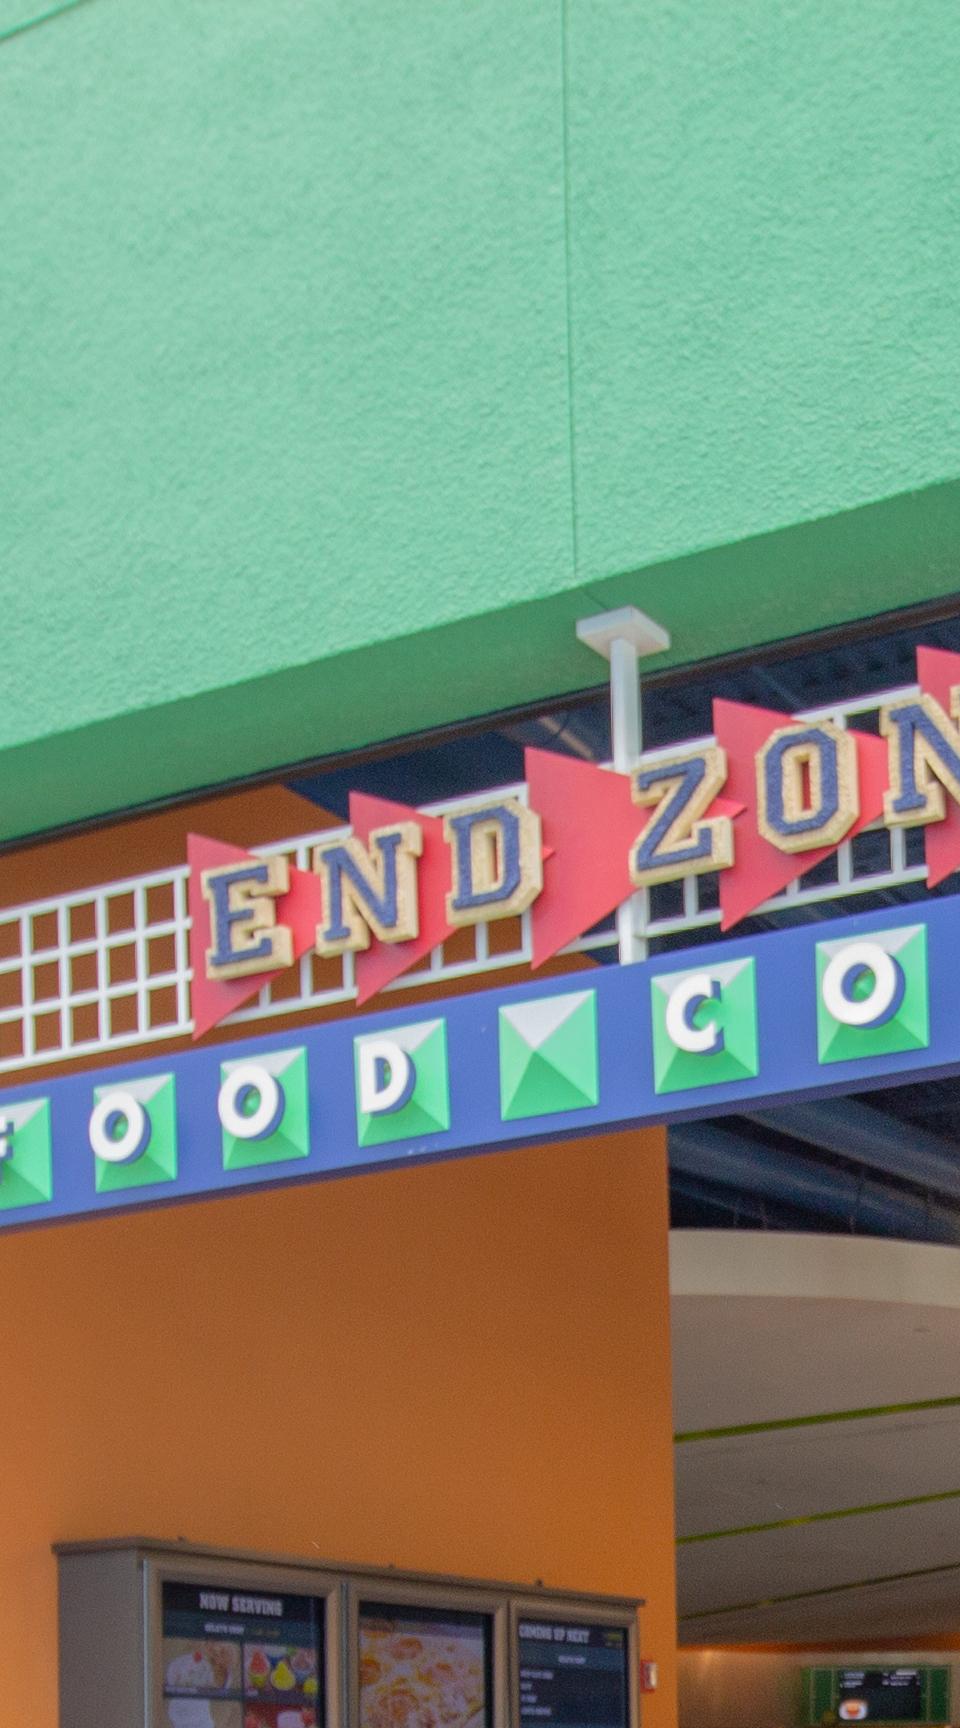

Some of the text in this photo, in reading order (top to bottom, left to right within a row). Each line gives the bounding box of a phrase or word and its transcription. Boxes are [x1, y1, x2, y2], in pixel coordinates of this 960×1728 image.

[201, 799, 544, 981] END
[0, 1041, 416, 1163] OOD
[200, 1592, 283, 1617] NOW SERVING
